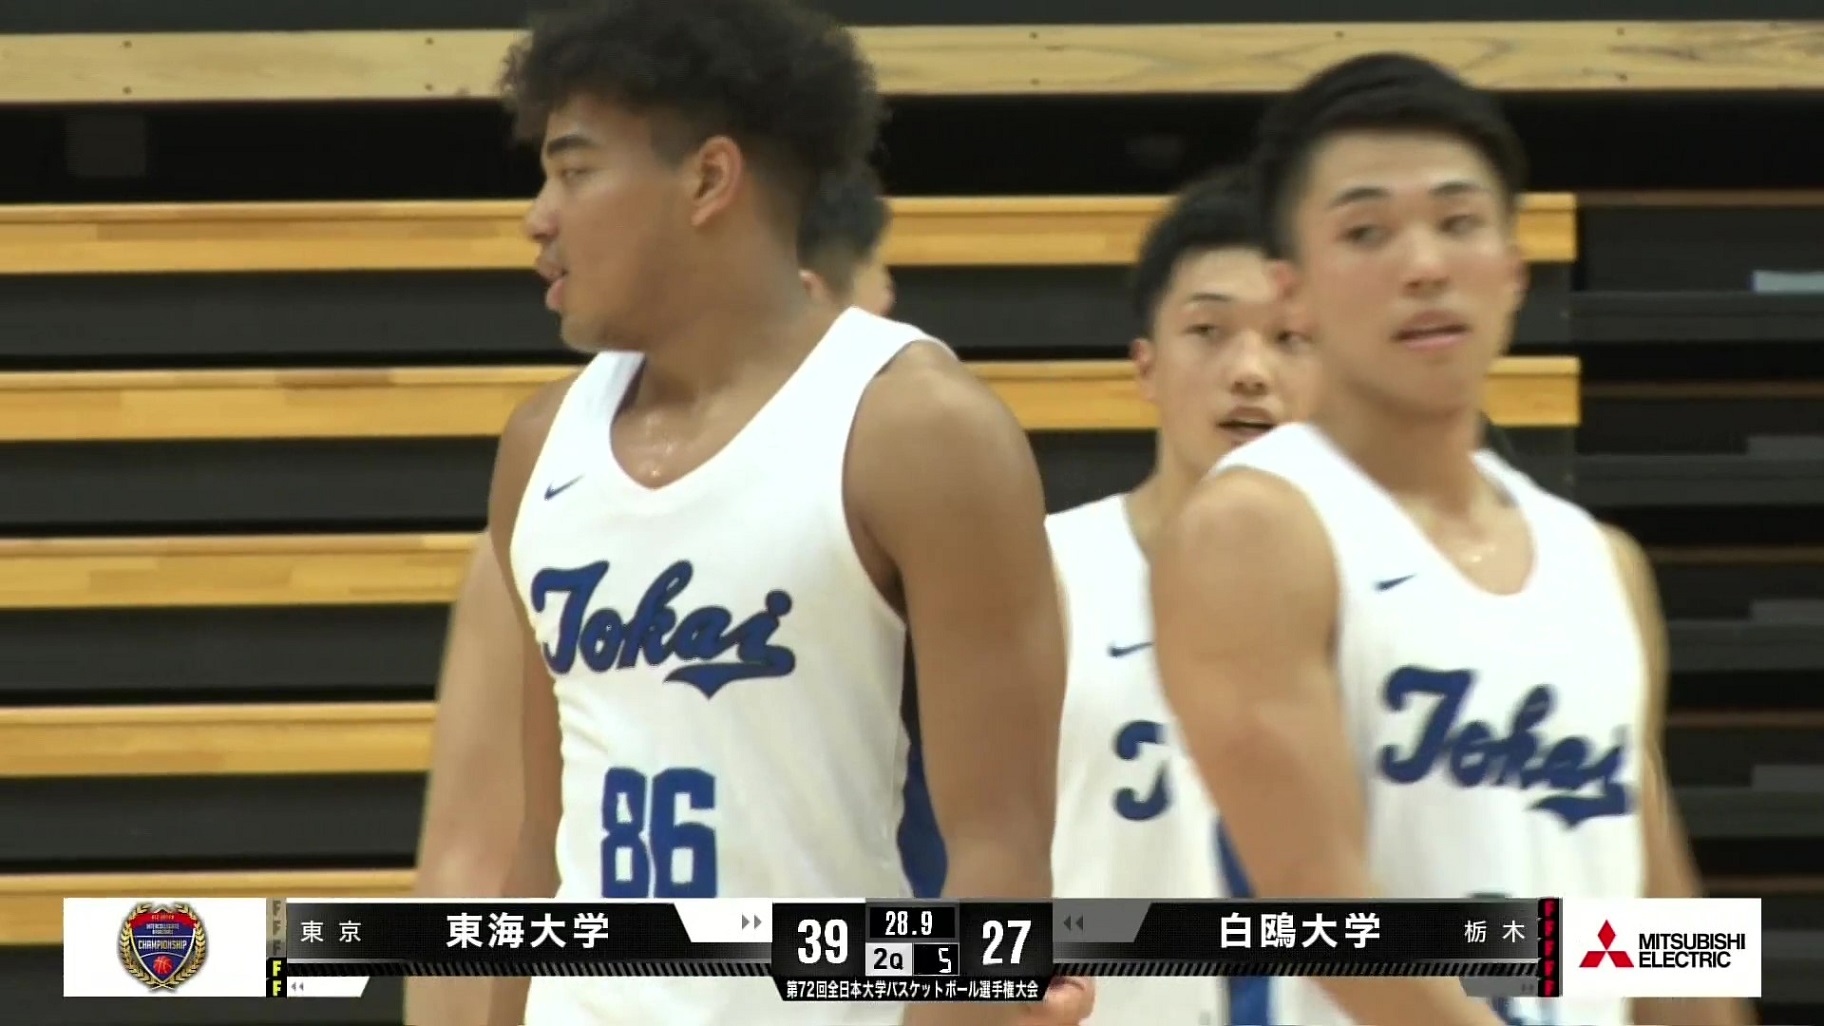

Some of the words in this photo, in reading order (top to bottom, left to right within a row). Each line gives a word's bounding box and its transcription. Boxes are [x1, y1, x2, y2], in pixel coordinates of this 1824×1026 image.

[531, 559, 796, 700] Tokai
[1378, 664, 1638, 830] Tokai
[601, 766, 718, 898] 86
